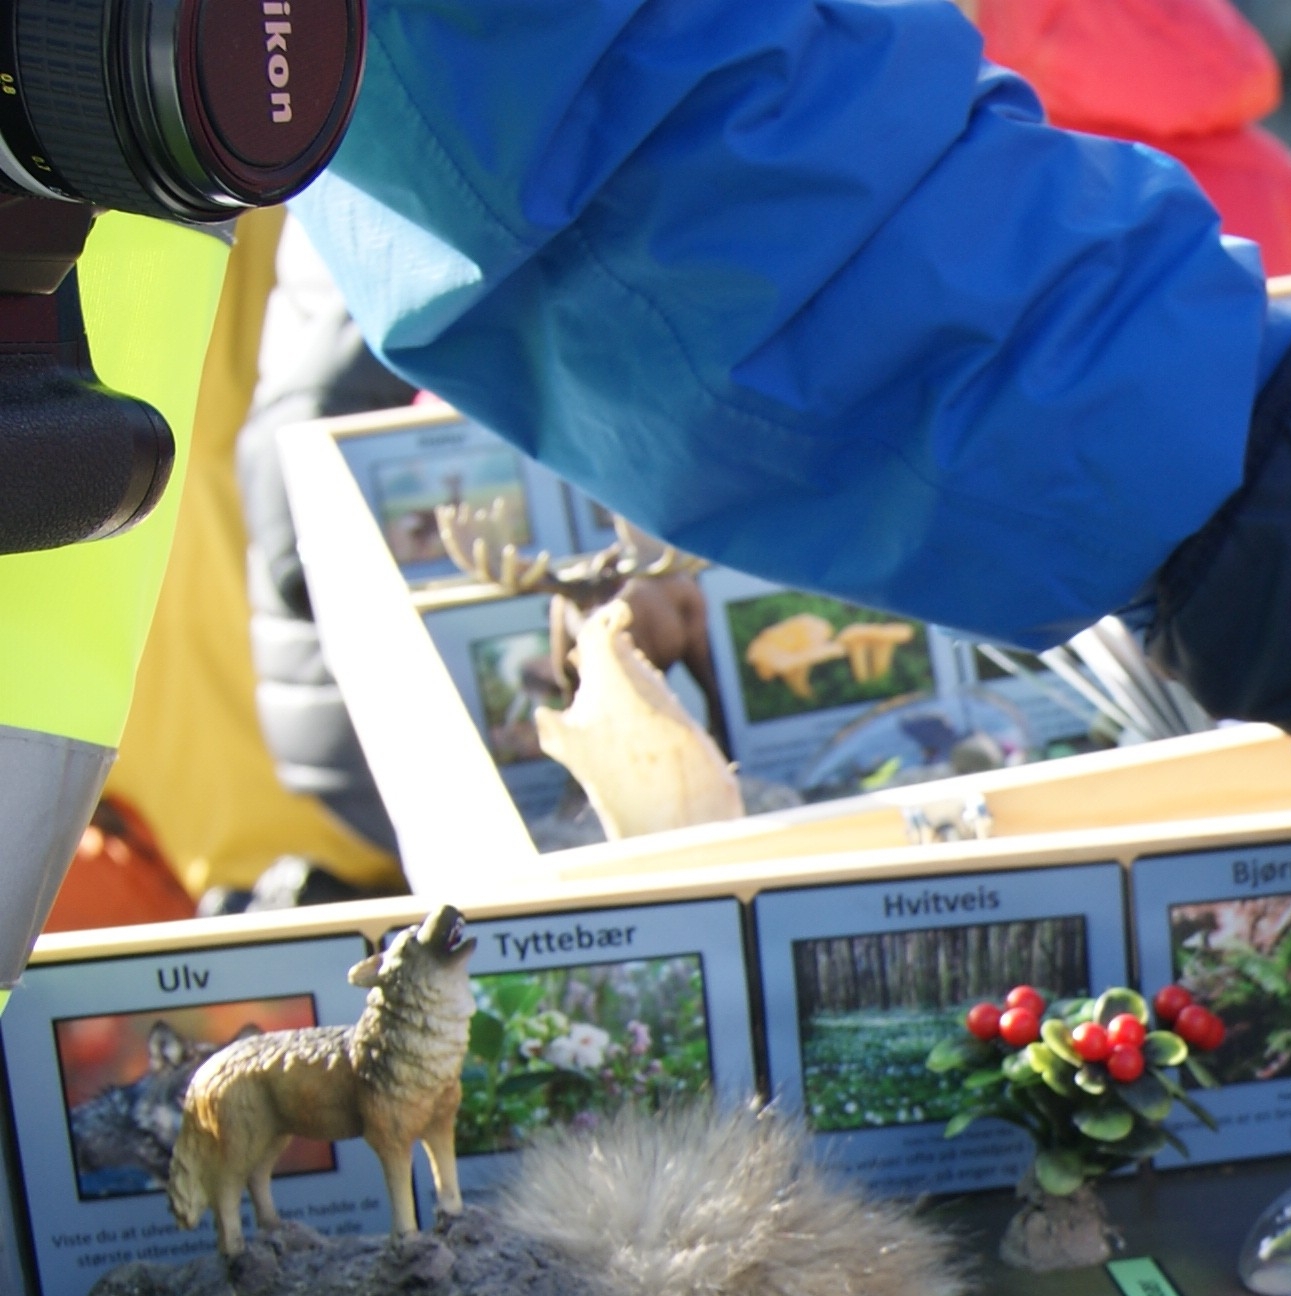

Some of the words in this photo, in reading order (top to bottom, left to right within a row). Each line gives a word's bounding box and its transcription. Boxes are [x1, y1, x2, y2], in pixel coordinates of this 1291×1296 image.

[263, 1, 293, 123] ikon
[883, 884, 1001, 919] Hvitveis
[494, 922, 637, 958] Tyttebær
[157, 965, 210, 993] Ulv
